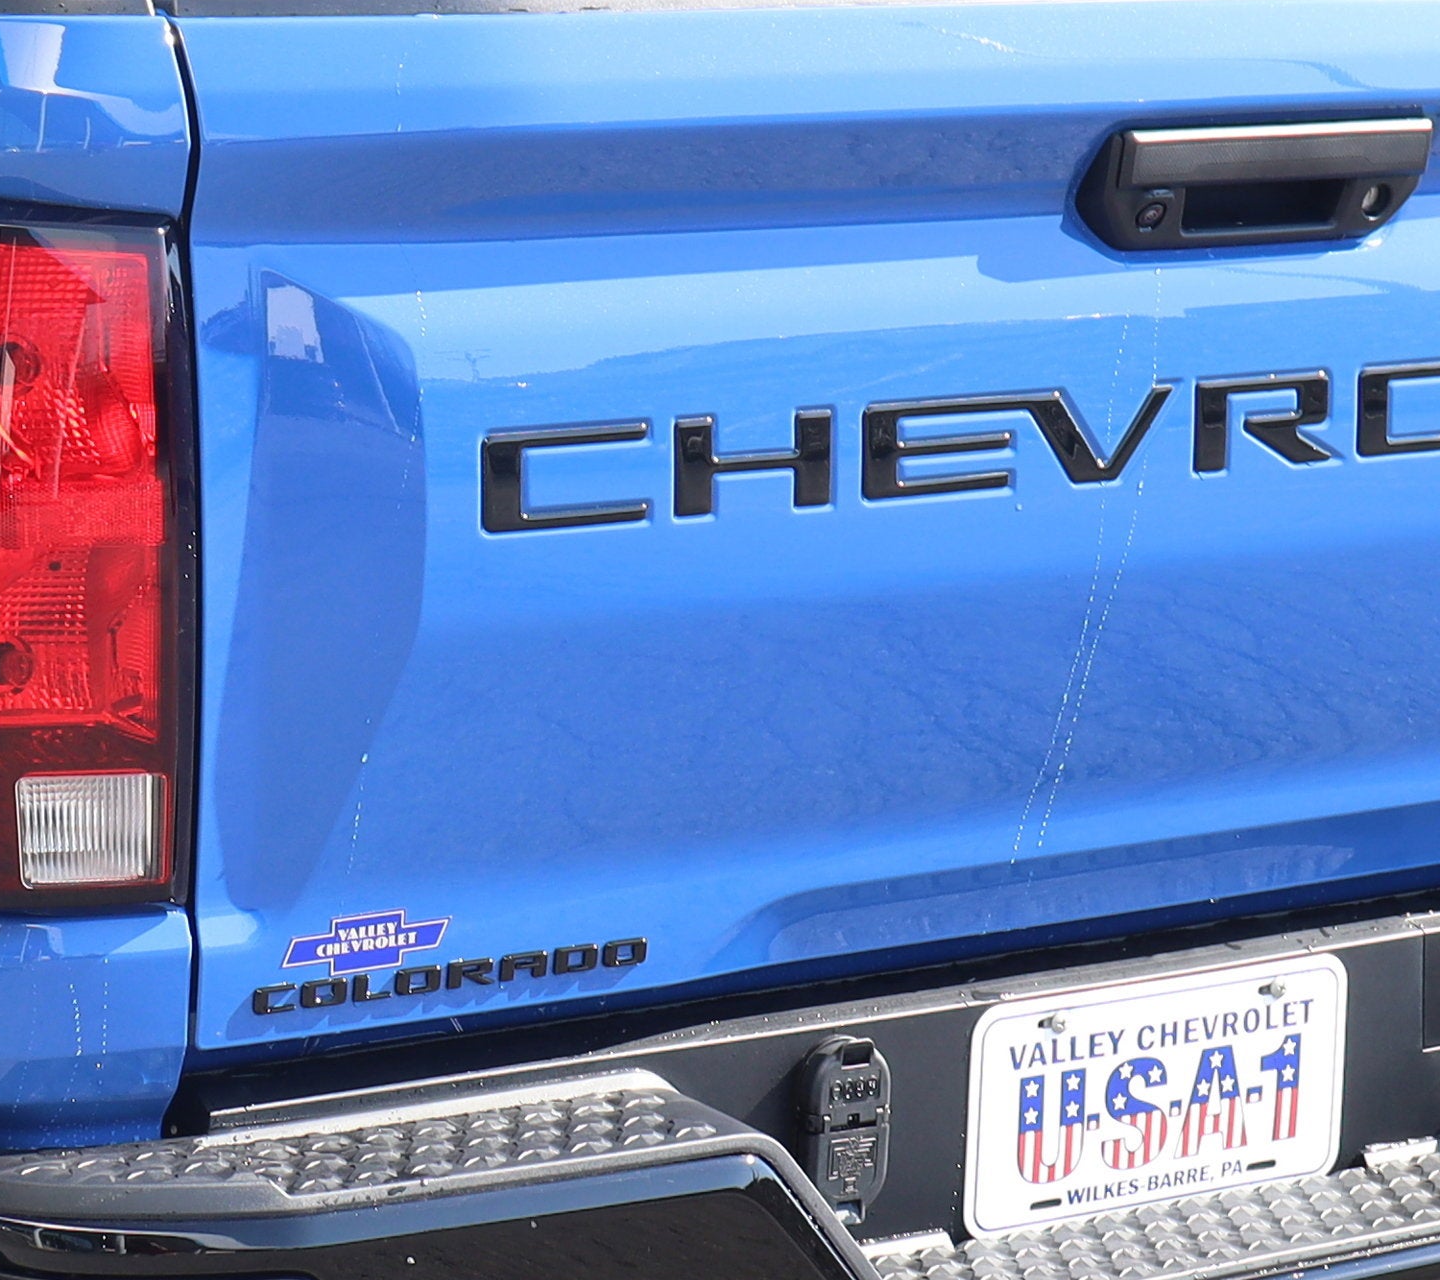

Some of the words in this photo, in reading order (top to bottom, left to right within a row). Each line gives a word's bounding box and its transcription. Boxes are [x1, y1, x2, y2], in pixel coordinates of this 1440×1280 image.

[315, 931, 418, 958] CHEVROLET
[337, 921, 401, 942] VALLEY
[251, 937, 648, 1016] COLORADO
[1008, 1028, 1126, 1072] VALLEY
[1136, 998, 1315, 1051] CHEVROLET
[1066, 1165, 1215, 1206] WILKES-BARRE,
[1221, 1159, 1243, 1177] PA
